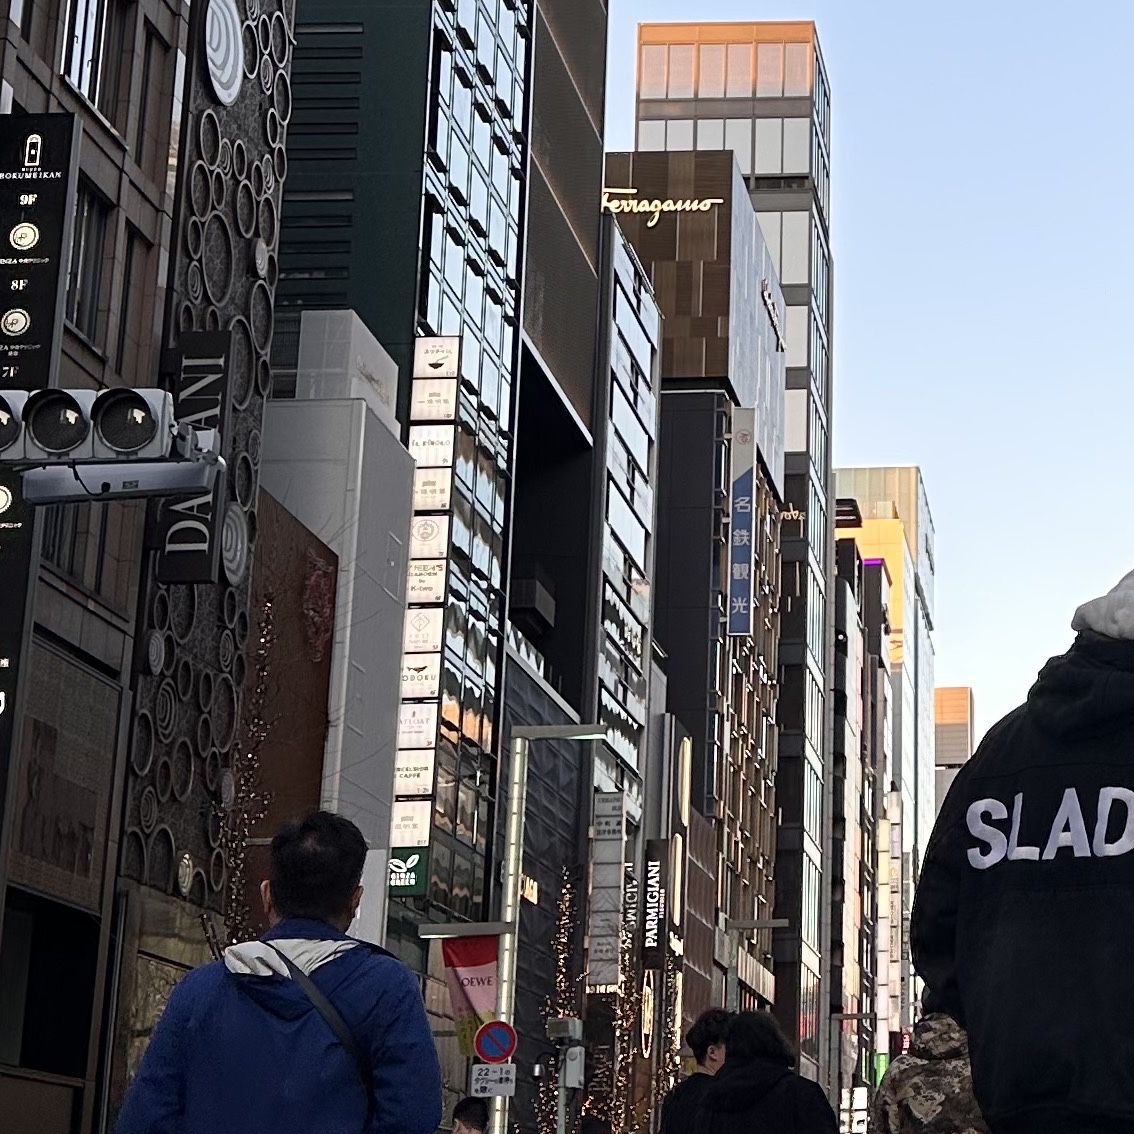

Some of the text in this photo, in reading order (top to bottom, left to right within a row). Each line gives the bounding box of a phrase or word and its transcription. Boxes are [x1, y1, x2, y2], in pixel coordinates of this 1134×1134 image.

[19, 194, 38, 206] 9F
[601, 188, 724, 227] Ferragamo
[10, 279, 29, 291] 8F
[731, 496, 751, 615] 名鉄観光
[645, 860, 661, 948] PARMIGIANI
